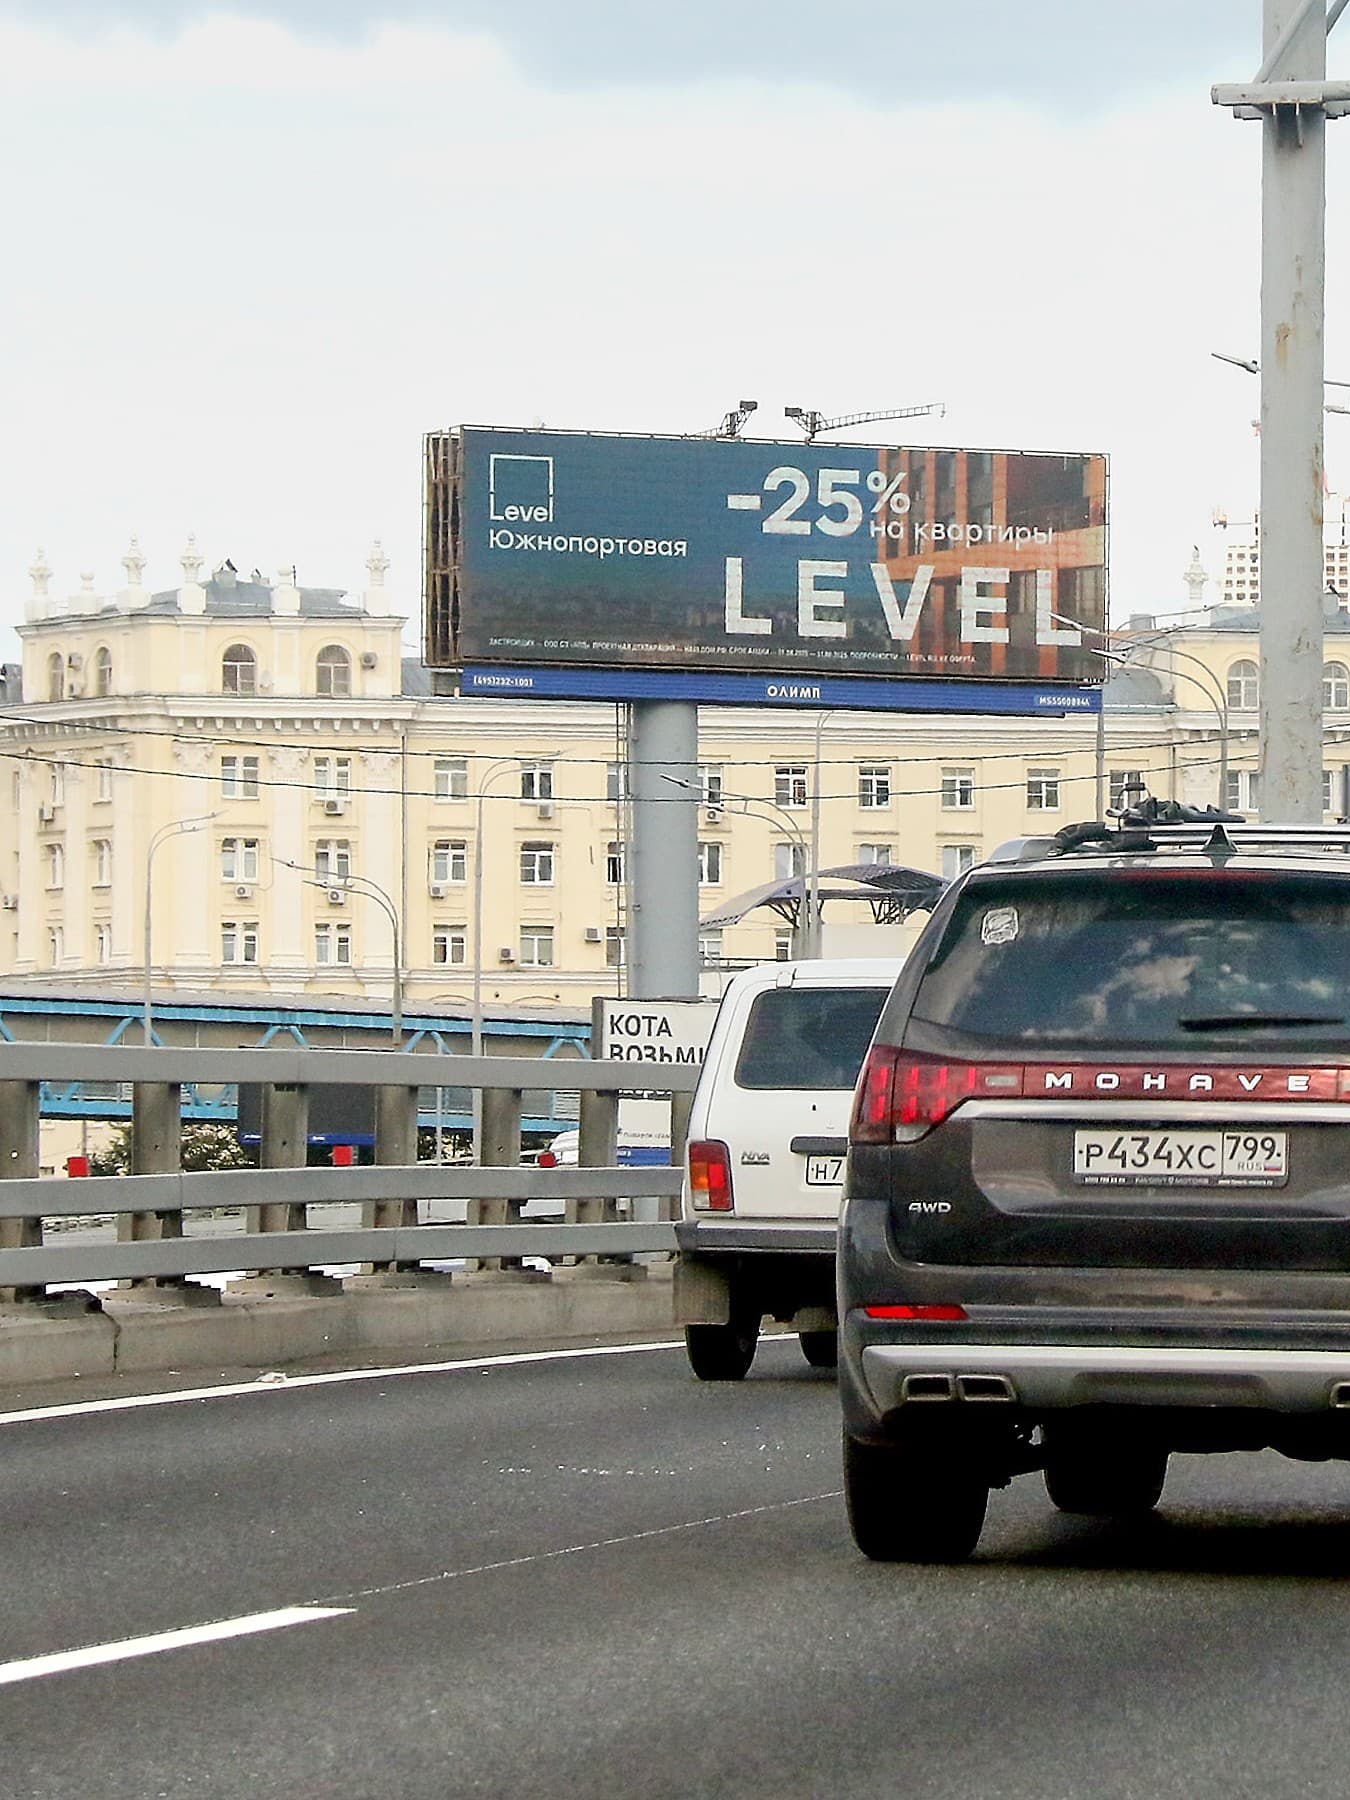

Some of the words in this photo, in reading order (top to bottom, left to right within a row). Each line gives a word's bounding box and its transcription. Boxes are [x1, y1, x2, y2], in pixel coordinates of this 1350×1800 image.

[490, 494, 553, 523] Level
[727, 466, 911, 537] -25%
[489, 528, 688, 559] Южнопортовая
[869, 520, 904, 539] на
[914, 520, 1054, 550] квартиры
[725, 556, 1083, 647] LEVEL
[767, 684, 820, 698] ОЛИМП
[609, 1014, 673, 1038] КОТА
[1045, 1072, 1311, 1092] MOHAVE
[1225, 1135, 1277, 1161] 799
